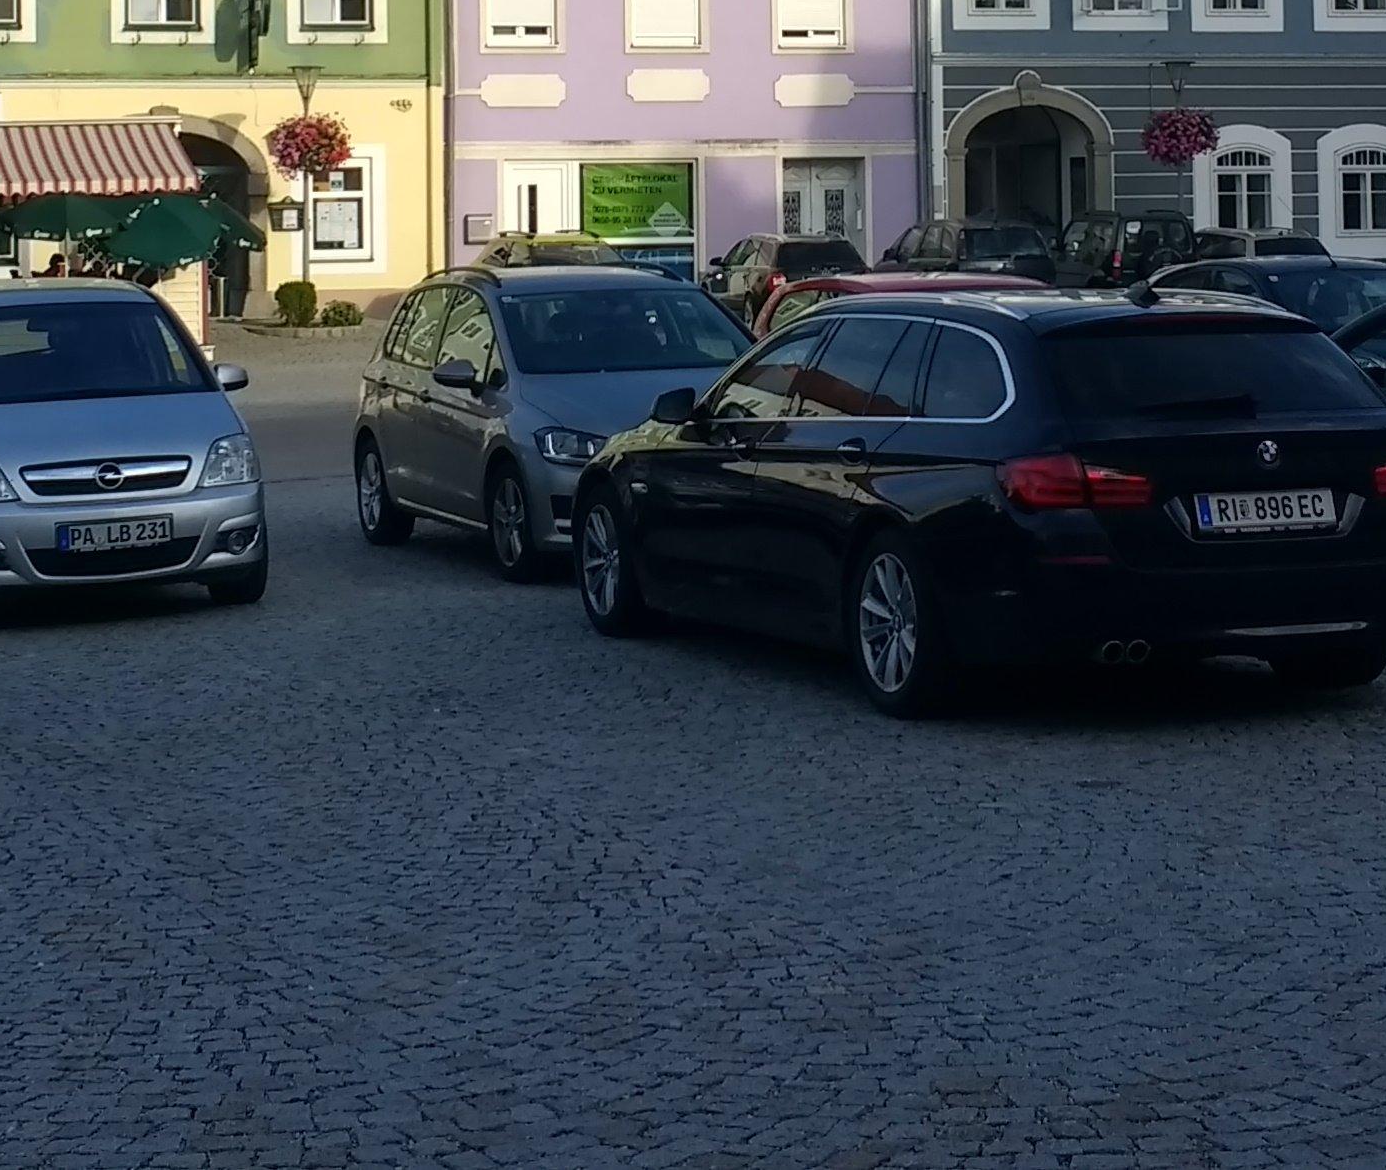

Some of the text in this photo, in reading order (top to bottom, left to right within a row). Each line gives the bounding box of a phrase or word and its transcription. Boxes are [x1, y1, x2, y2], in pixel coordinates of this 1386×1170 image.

[607, 186, 662, 195] VERMIETEN
[1217, 498, 1239, 522] RI
[1254, 495, 1294, 520] 896
[1297, 494, 1325, 518] EC
[71, 521, 170, 546] PA LB 231
